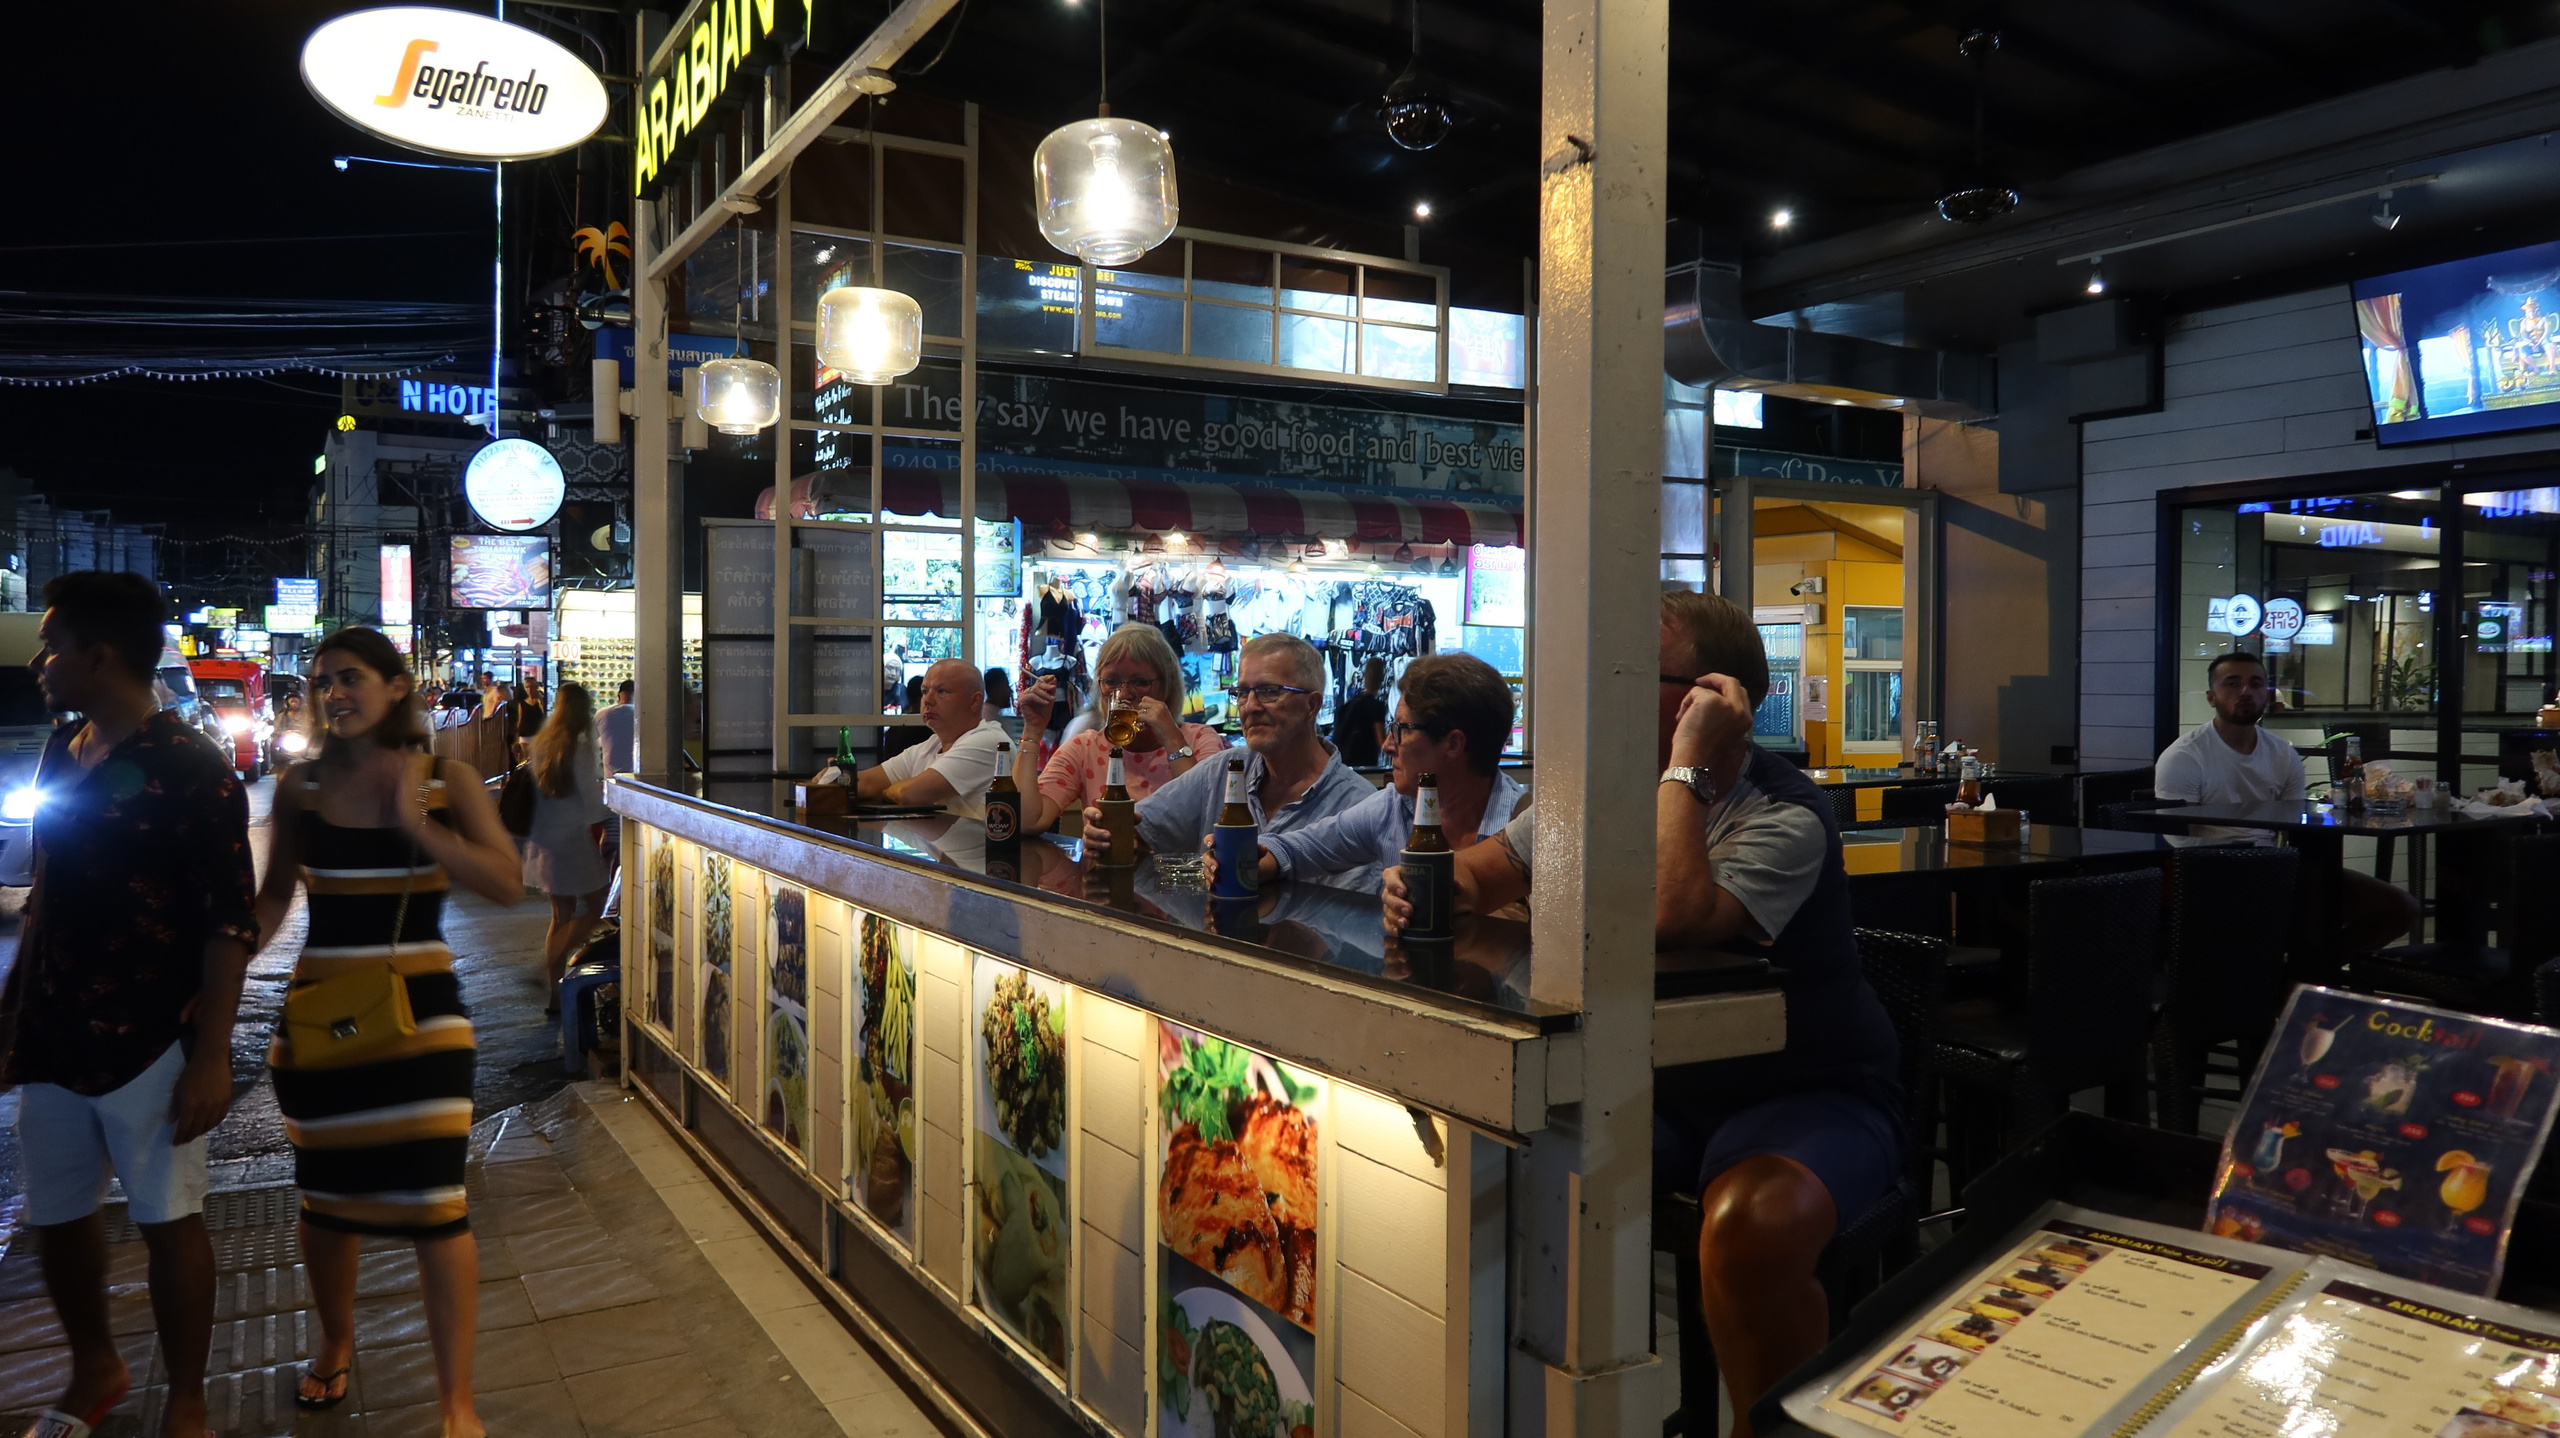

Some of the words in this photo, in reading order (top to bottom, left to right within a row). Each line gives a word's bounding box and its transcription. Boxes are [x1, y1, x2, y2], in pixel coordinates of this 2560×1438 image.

[373, 39, 548, 115] Segafredo
[635, 0, 774, 197] ARABIAN
[456, 106, 514, 122] ZANETTI
[1049, 266, 1077, 278] JUST
[428, 384, 498, 415] HOTE
[997, 401, 1050, 436] say
[1061, 407, 1106, 435] we
[1120, 406, 1191, 443] have
[1204, 421, 1277, 451] good
[1289, 421, 1355, 458] food
[1366, 430, 1418, 464] and
[1424, 432, 1481, 469] best
[1487, 440, 1524, 472] vie
[475, 443, 523, 468] PIZZERIA
[473, 545, 526, 554] TOMAHAWK
[480, 538, 497, 546] THE
[500, 538, 521, 546] BEST
[553, 643, 579, 659] 100
[2366, 1010, 2485, 1049] Cocktail
[2088, 1231, 2153, 1250] ARABIAN
[2387, 1300, 2480, 1331] ARABIAN
